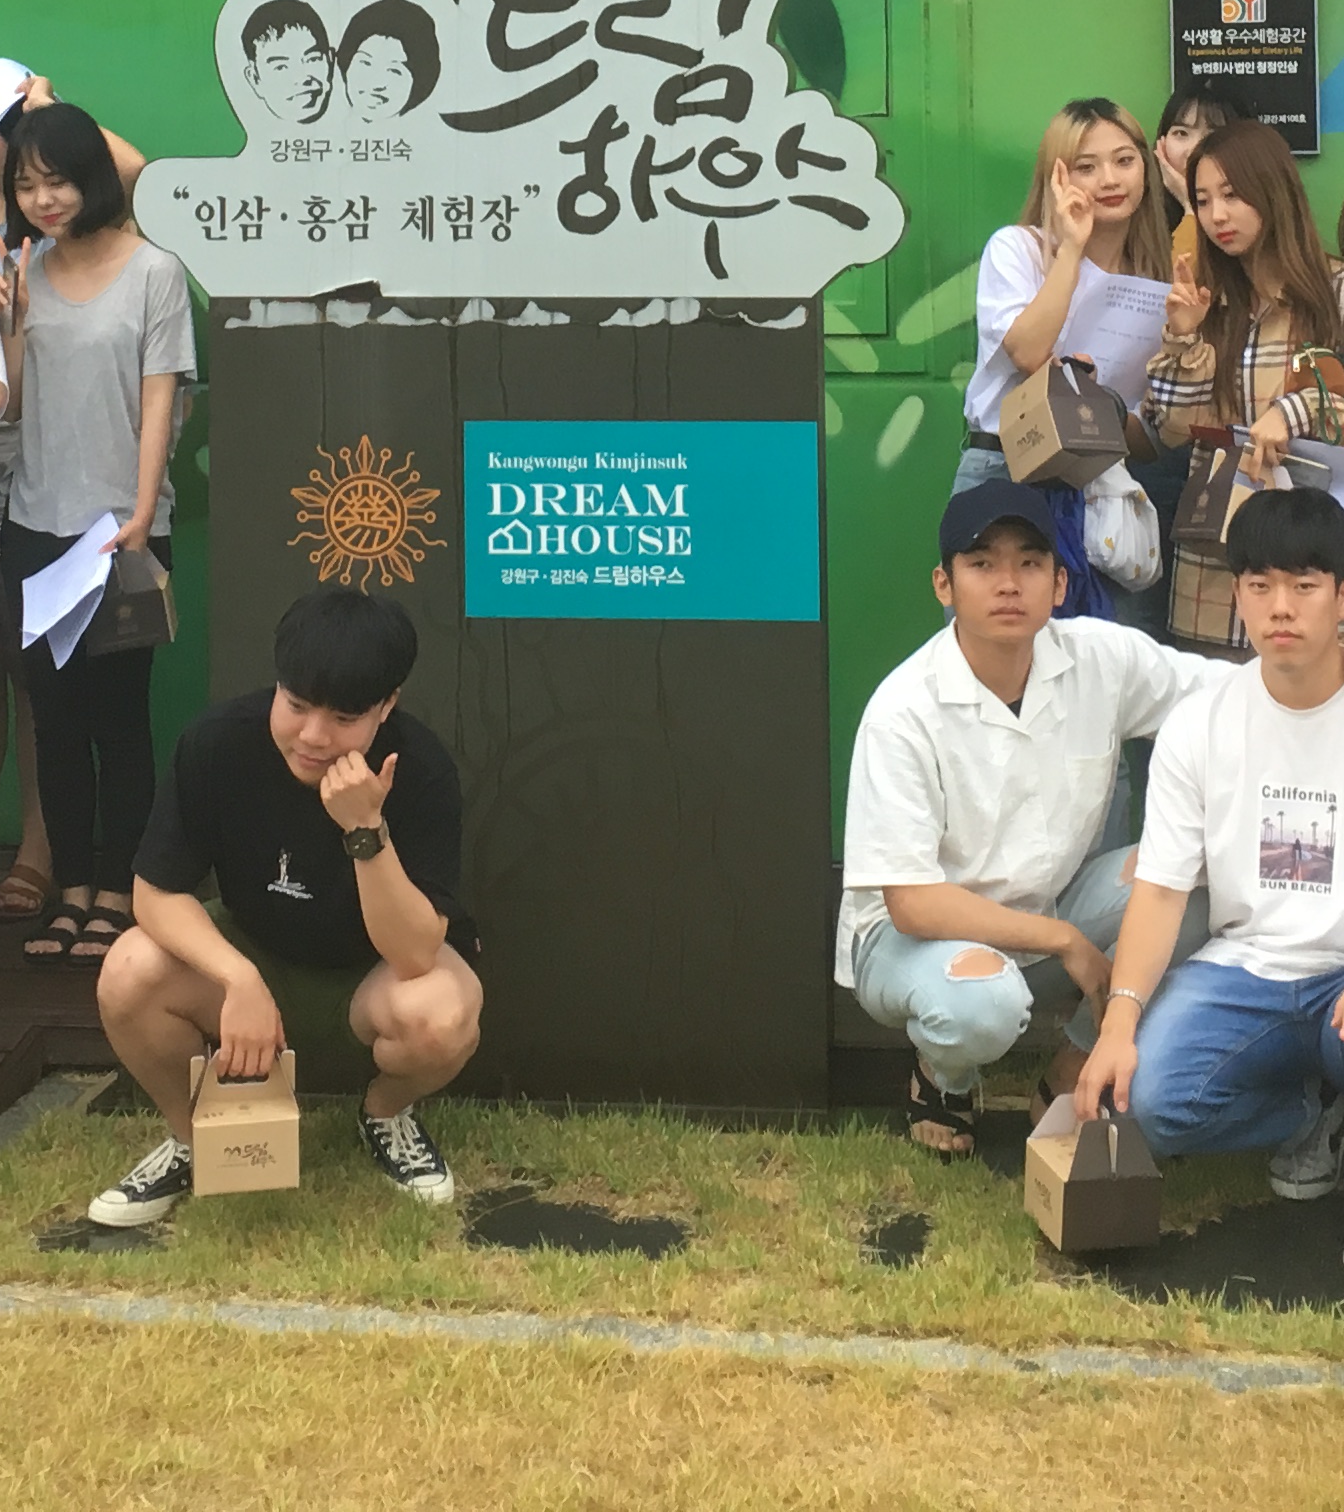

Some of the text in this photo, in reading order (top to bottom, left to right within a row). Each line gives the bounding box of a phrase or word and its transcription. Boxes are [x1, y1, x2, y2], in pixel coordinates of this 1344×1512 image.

[1182, 27, 1308, 46] 식생활 우수체험공간
[1191, 61, 1255, 75] 농업회사법인
[555, 105, 870, 280] 하우스
[487, 451, 688, 473] Kangwongu Kimjinsuk
[486, 482, 690, 518] DREAM
[535, 524, 692, 556] HOUSE
[592, 565, 686, 587] 드림하우스
[1261, 784, 1337, 803] California
[1259, 880, 1332, 895] SUN BEACH
